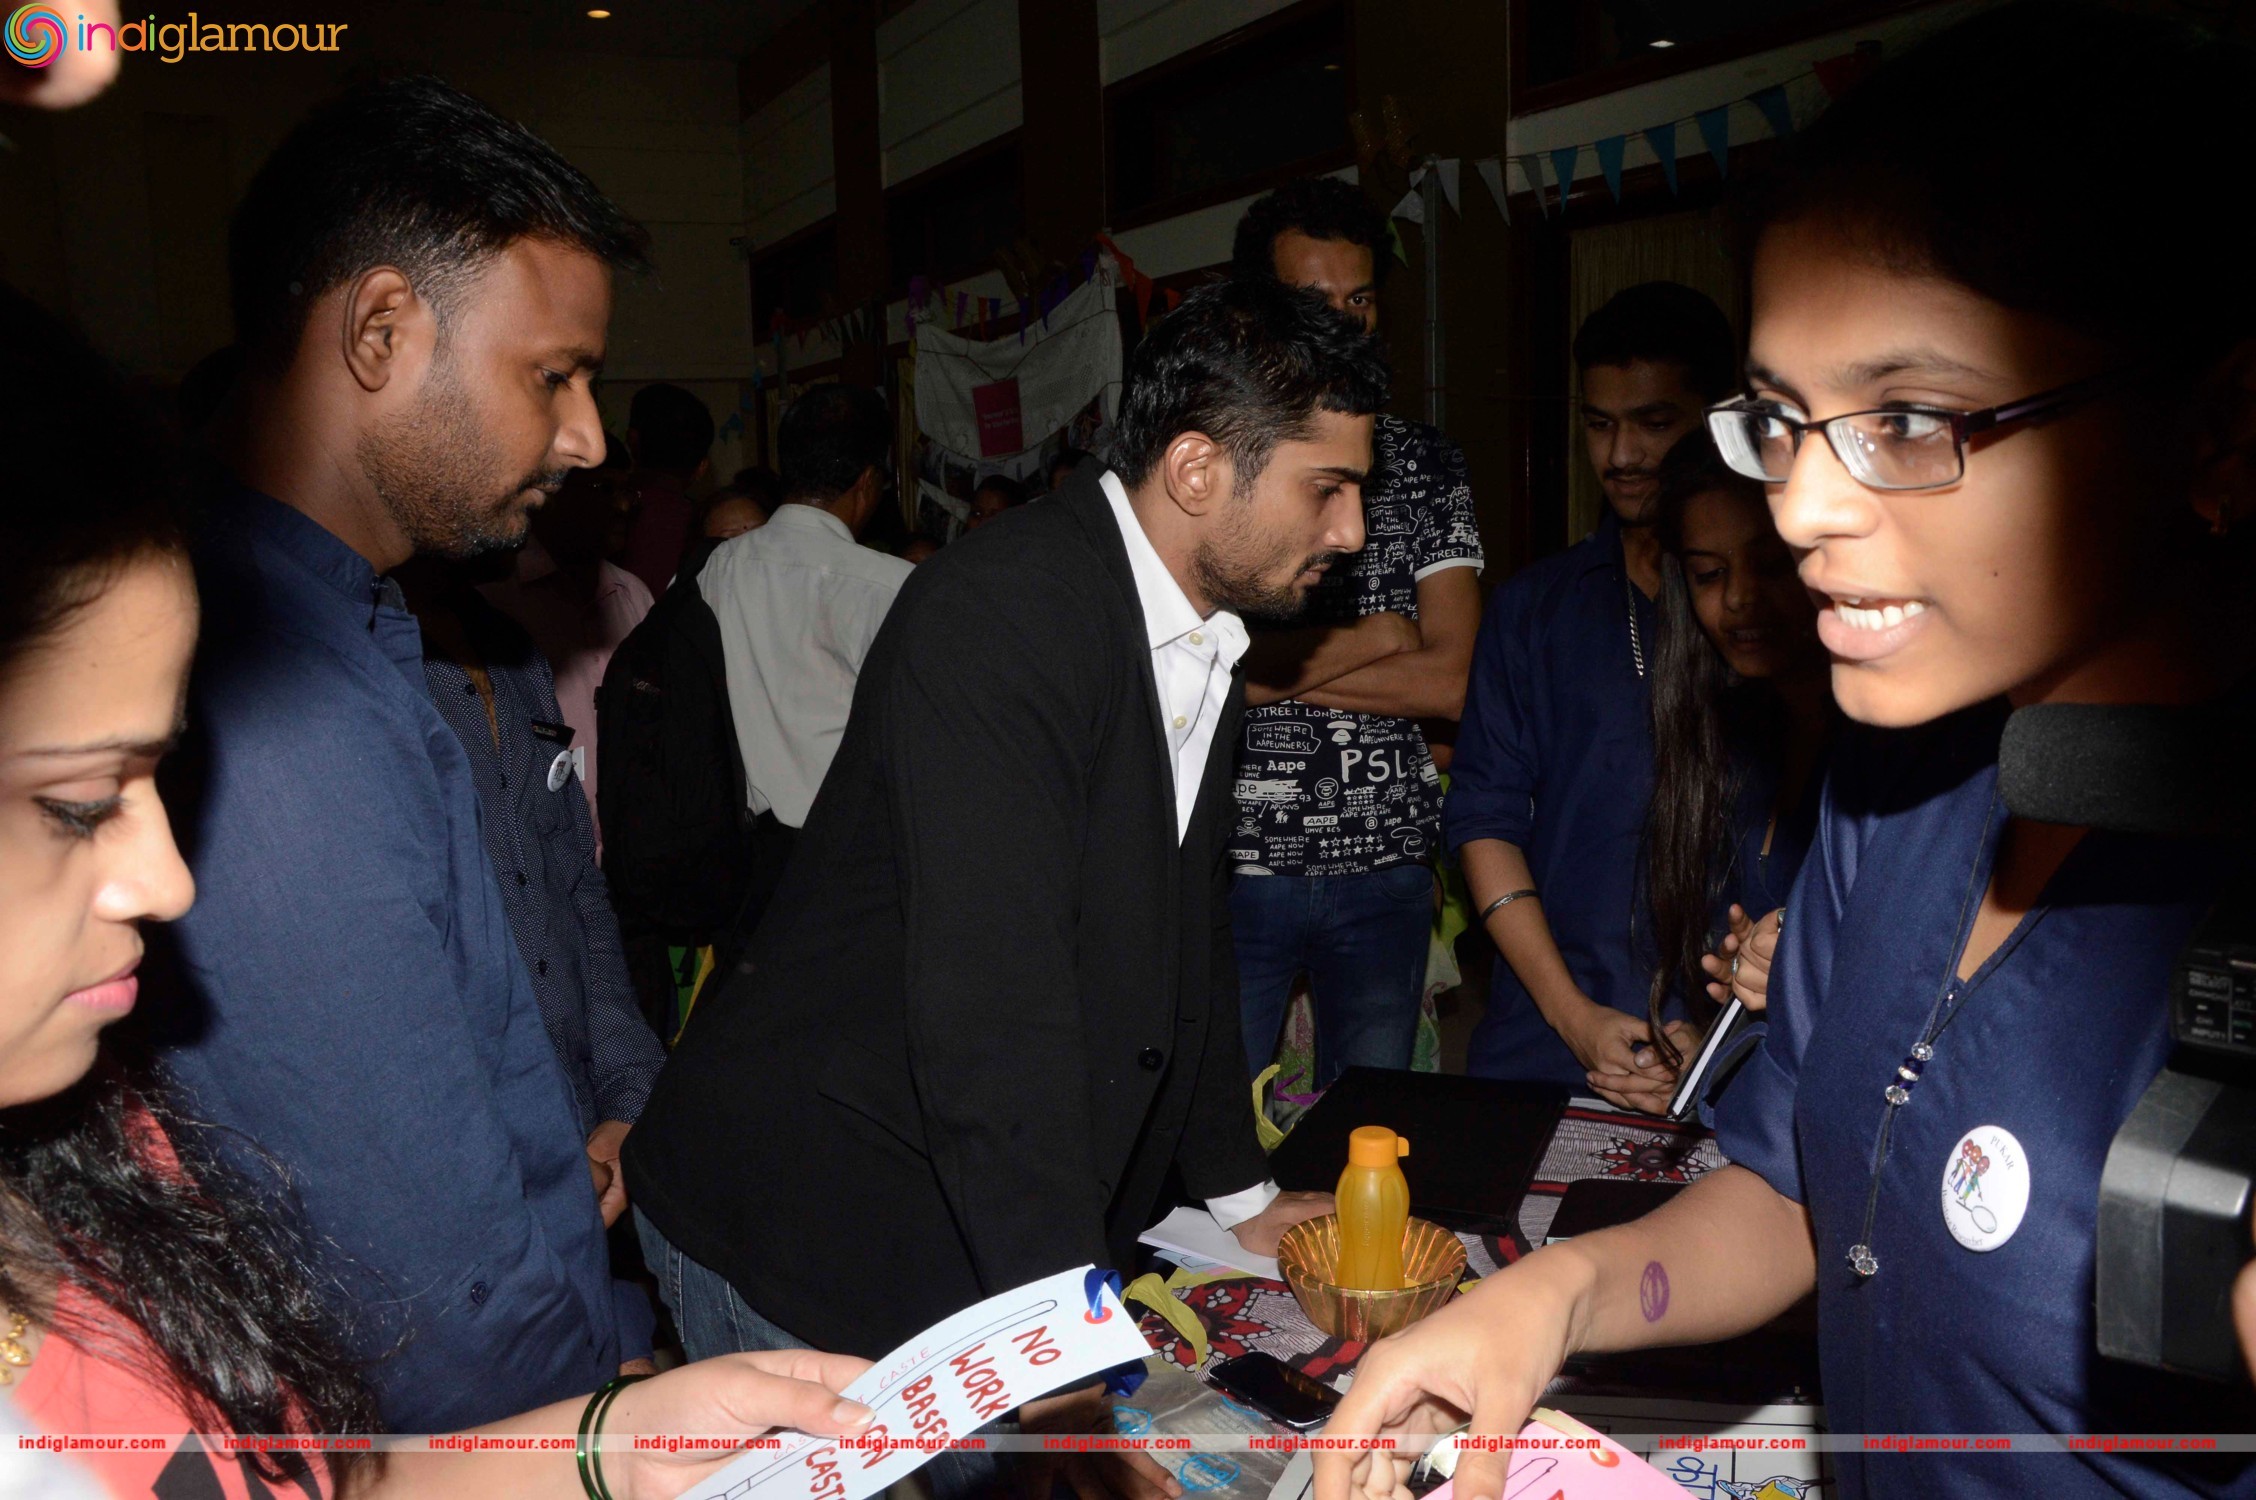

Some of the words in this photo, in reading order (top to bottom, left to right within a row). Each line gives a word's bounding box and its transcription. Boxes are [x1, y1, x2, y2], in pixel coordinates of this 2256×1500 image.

[1256, 706, 1301, 718] STREET
[1274, 733, 1291, 741] THE
[1266, 760, 1306, 774] Aape
[1341, 749, 1408, 783] PSL
[1307, 817, 1335, 825] AAPE
[1011, 1325, 1062, 1366] NO
[949, 1342, 1011, 1420] WORK
[805, 1446, 847, 1500] CAST
